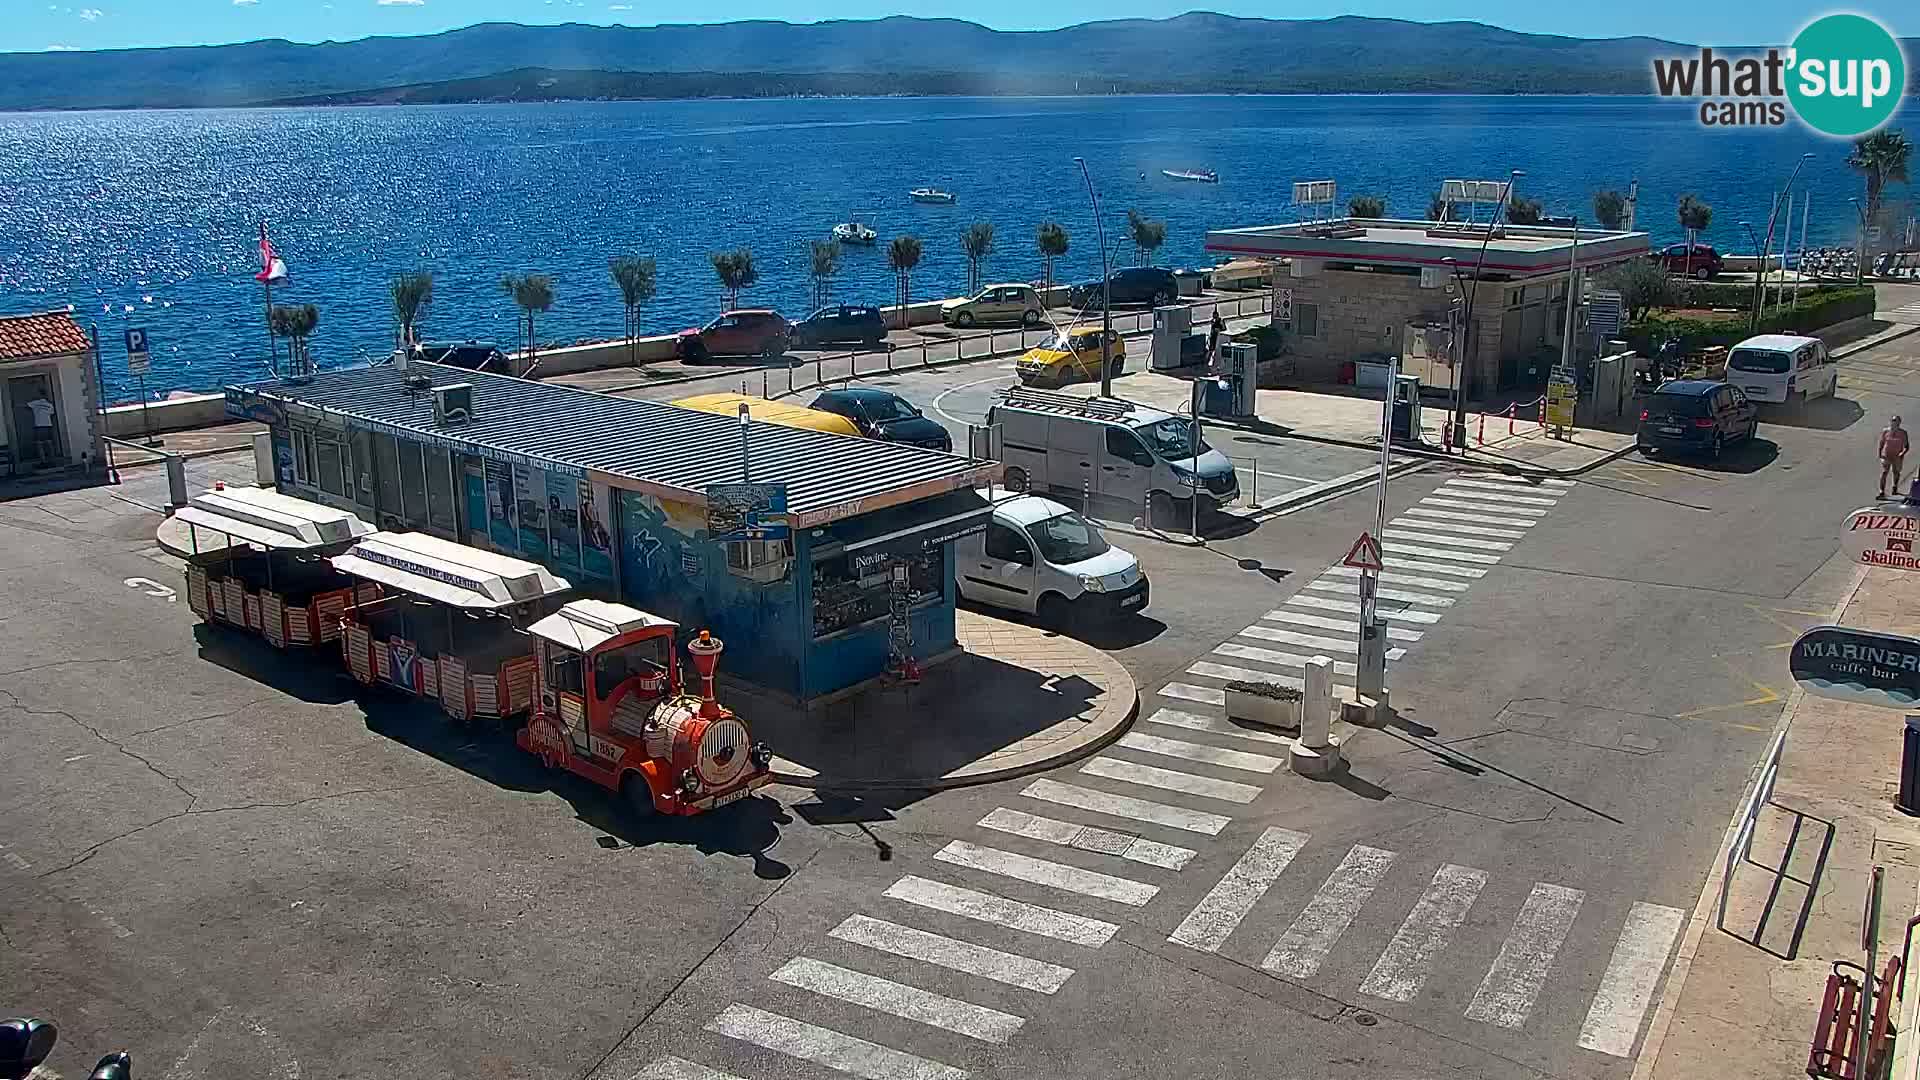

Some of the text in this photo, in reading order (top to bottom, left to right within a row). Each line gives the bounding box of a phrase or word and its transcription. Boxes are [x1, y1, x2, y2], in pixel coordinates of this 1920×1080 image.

[129, 330, 142, 350] P
[478, 447, 493, 458] BUS
[494, 450, 526, 465] STATION
[529, 458, 554, 472] TICKET
[555, 463, 583, 477] OFFICE
[1849, 515, 1920, 533] PIZZE
[1802, 641, 1920, 673] MARINER
[1829, 661, 1900, 680] caffe bar
